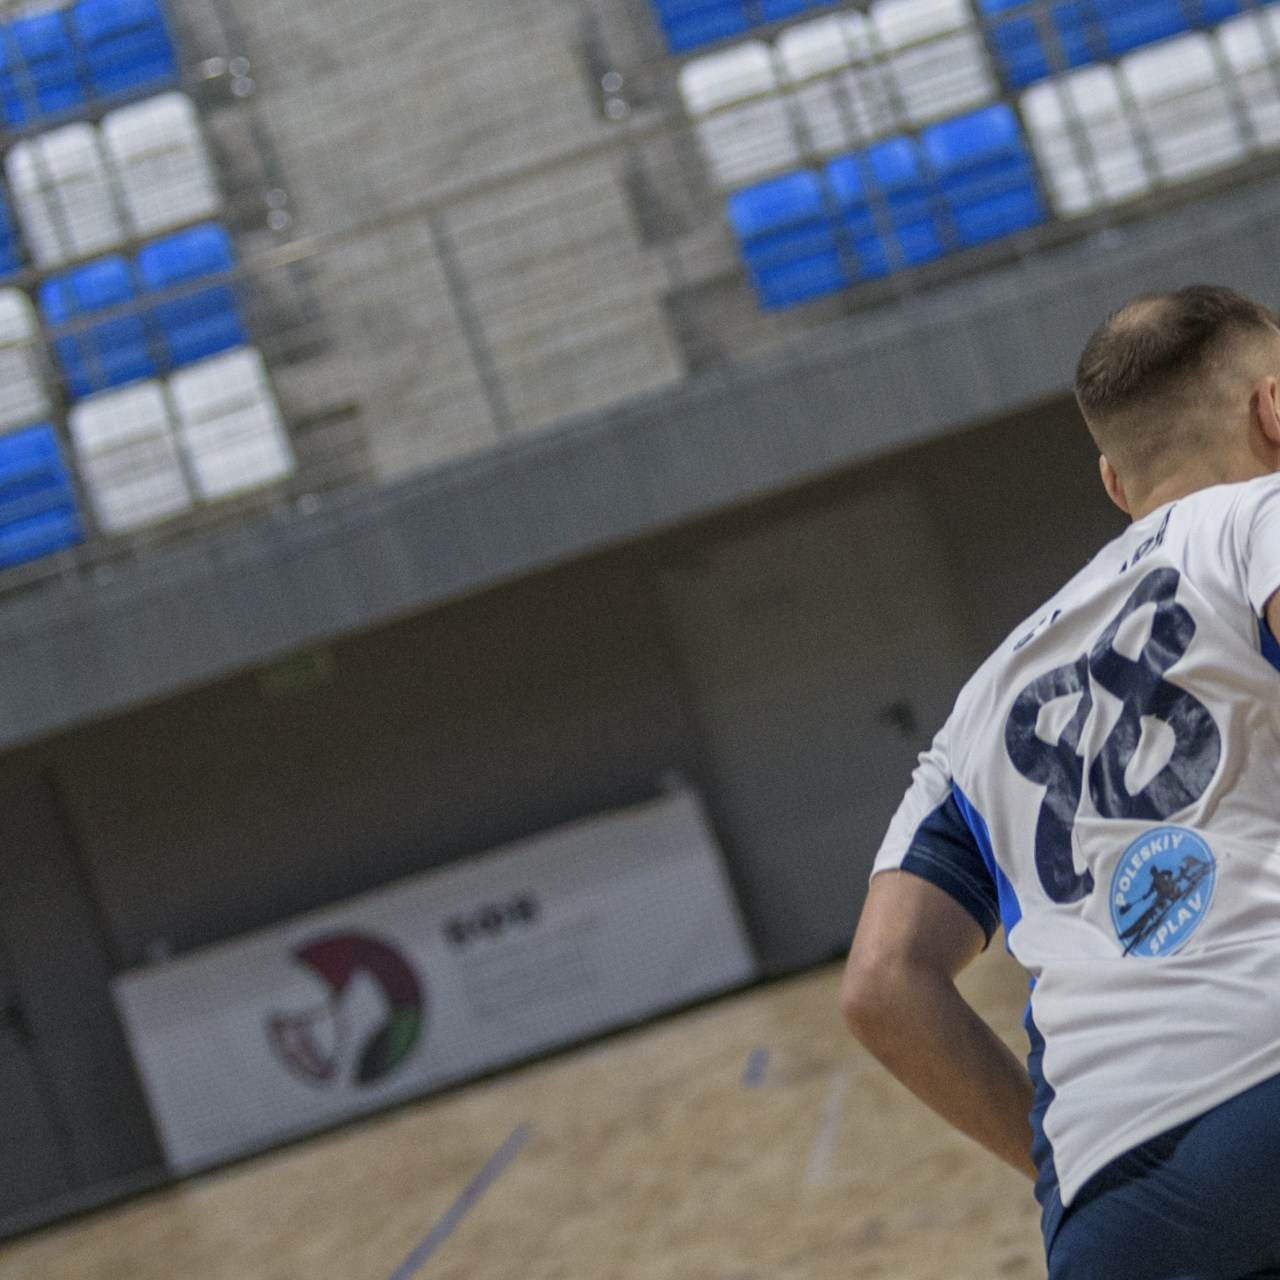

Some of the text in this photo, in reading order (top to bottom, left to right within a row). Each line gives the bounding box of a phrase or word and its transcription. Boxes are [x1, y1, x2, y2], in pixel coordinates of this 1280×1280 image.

[1005, 567, 1221, 904] 88
[1115, 833, 1184, 907] POLESKIY
[1150, 891, 1202, 956] SPLAV
